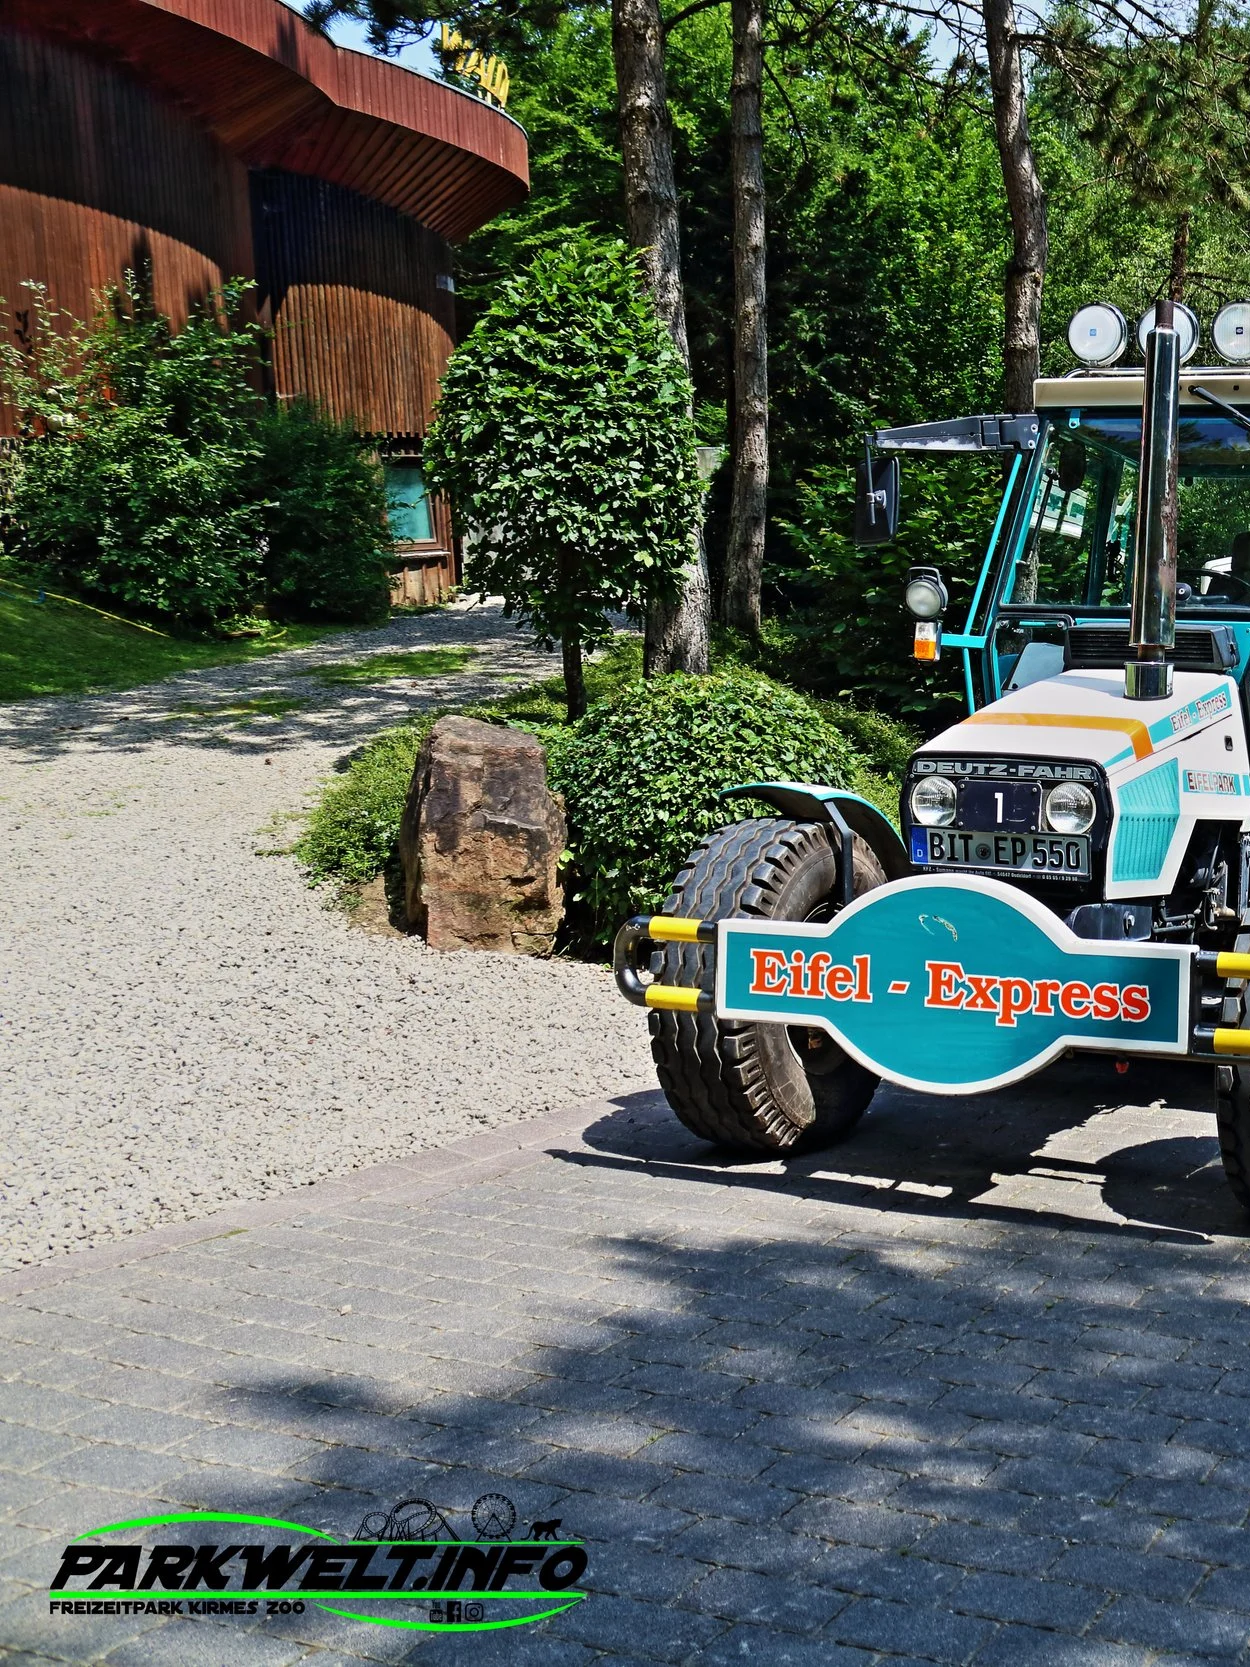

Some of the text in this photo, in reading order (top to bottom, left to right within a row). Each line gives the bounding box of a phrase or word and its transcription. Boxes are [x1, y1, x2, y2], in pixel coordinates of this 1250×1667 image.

[1171, 706, 1192, 732] Eifel
[1196, 693, 1227, 720] Express
[917, 761, 1094, 780] DEUTZ-FAHR
[1187, 772, 1235, 792] EIFELPARK
[994, 792, 1003, 824] 1
[916, 849, 923, 858] D
[929, 832, 973, 862] BIT
[749, 948, 872, 1003] Eifel
[925, 960, 1151, 1027] Express
